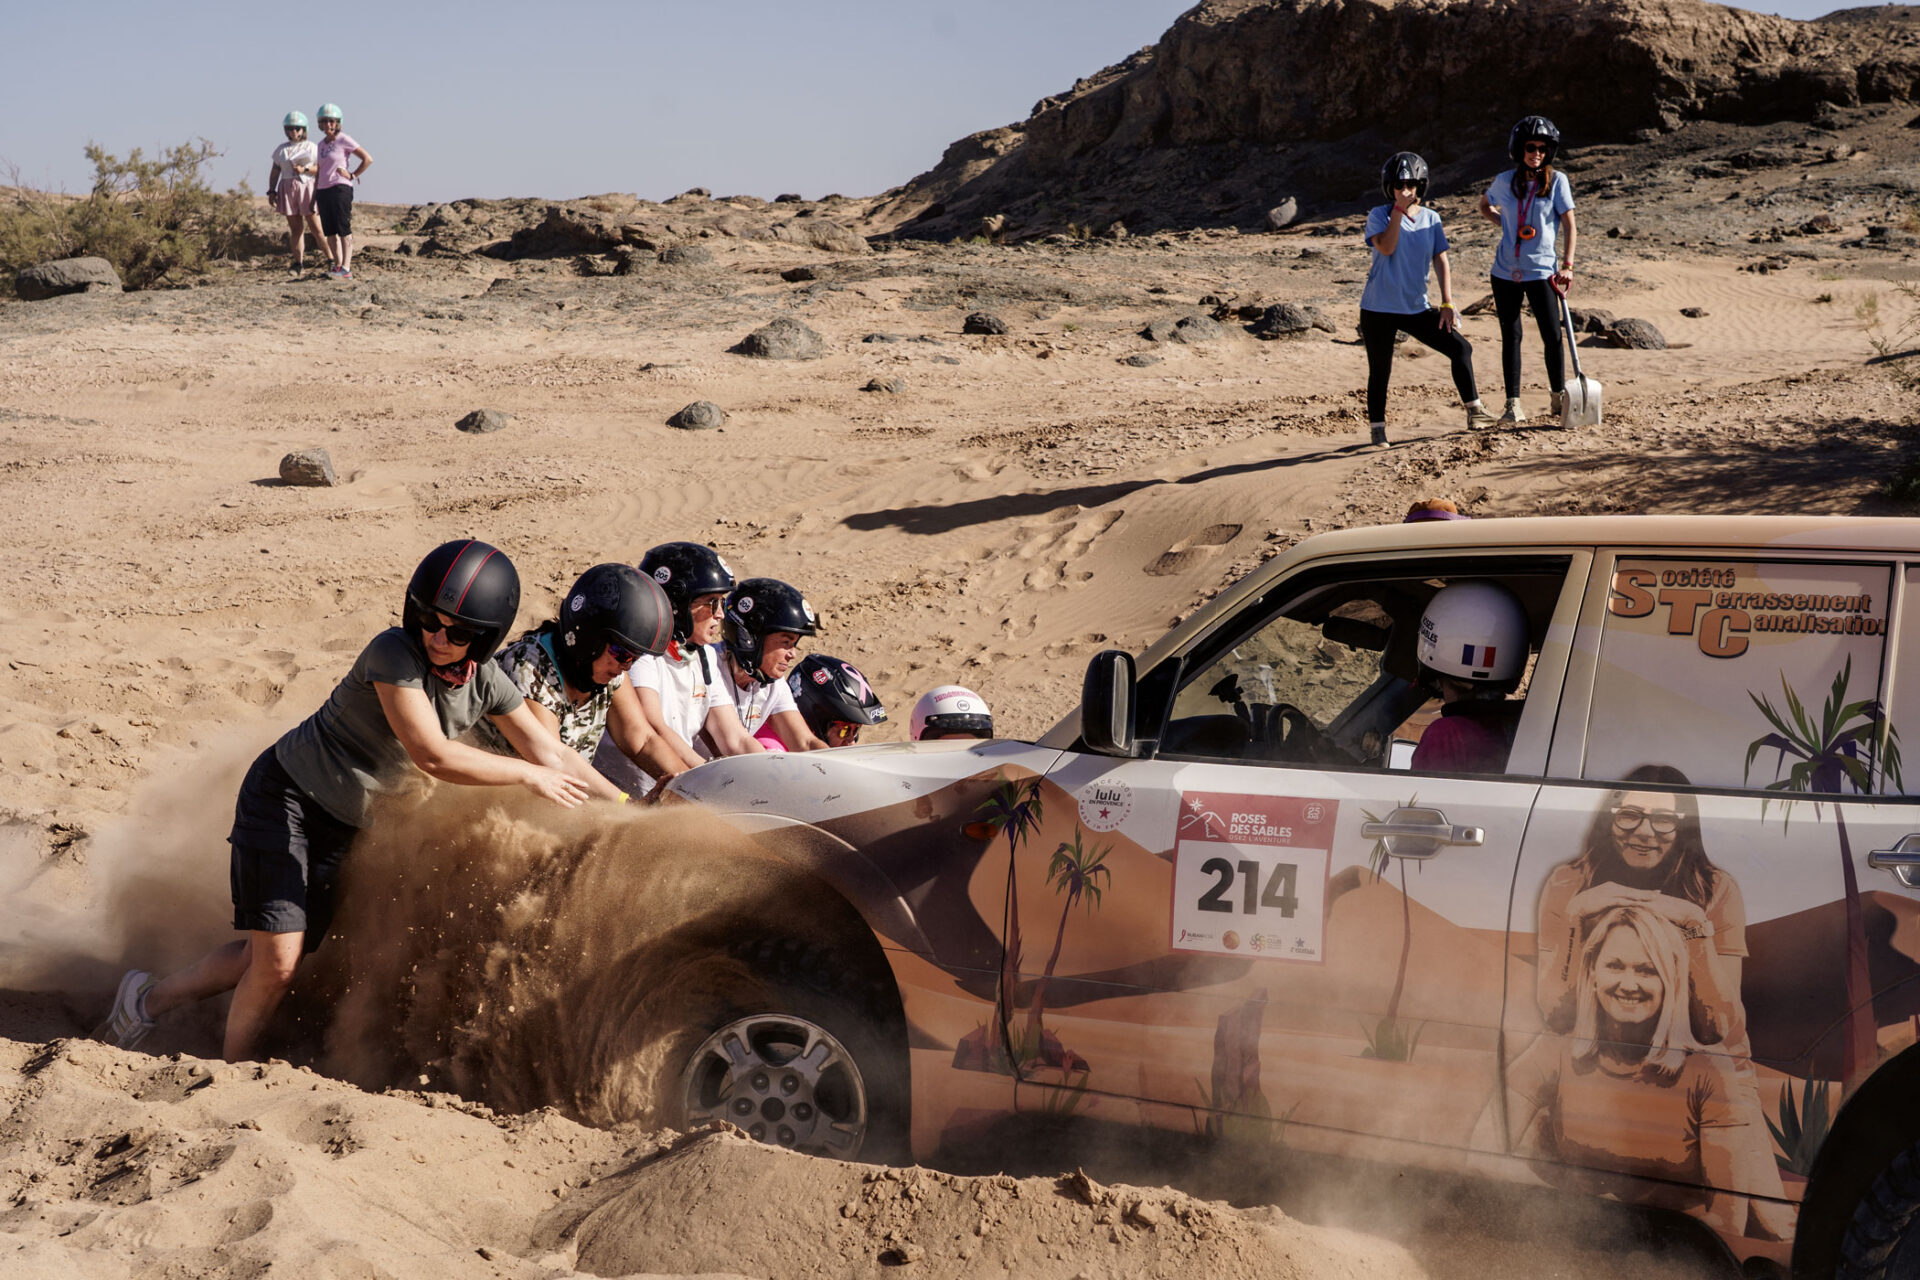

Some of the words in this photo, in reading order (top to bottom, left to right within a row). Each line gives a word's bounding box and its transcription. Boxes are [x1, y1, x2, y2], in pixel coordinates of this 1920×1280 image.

[655, 570, 669, 581] 205
[739, 599, 751, 611] 205
[1095, 789, 1121, 801] lulu
[1231, 812, 1267, 825] ROSES
[1229, 824, 1250, 835] DES
[1251, 825, 1292, 838] SABLES
[1228, 834, 1247, 842] OSEZ
[1249, 836, 1292, 845] L'AVENTURE
[1197, 857, 1299, 919] 214
